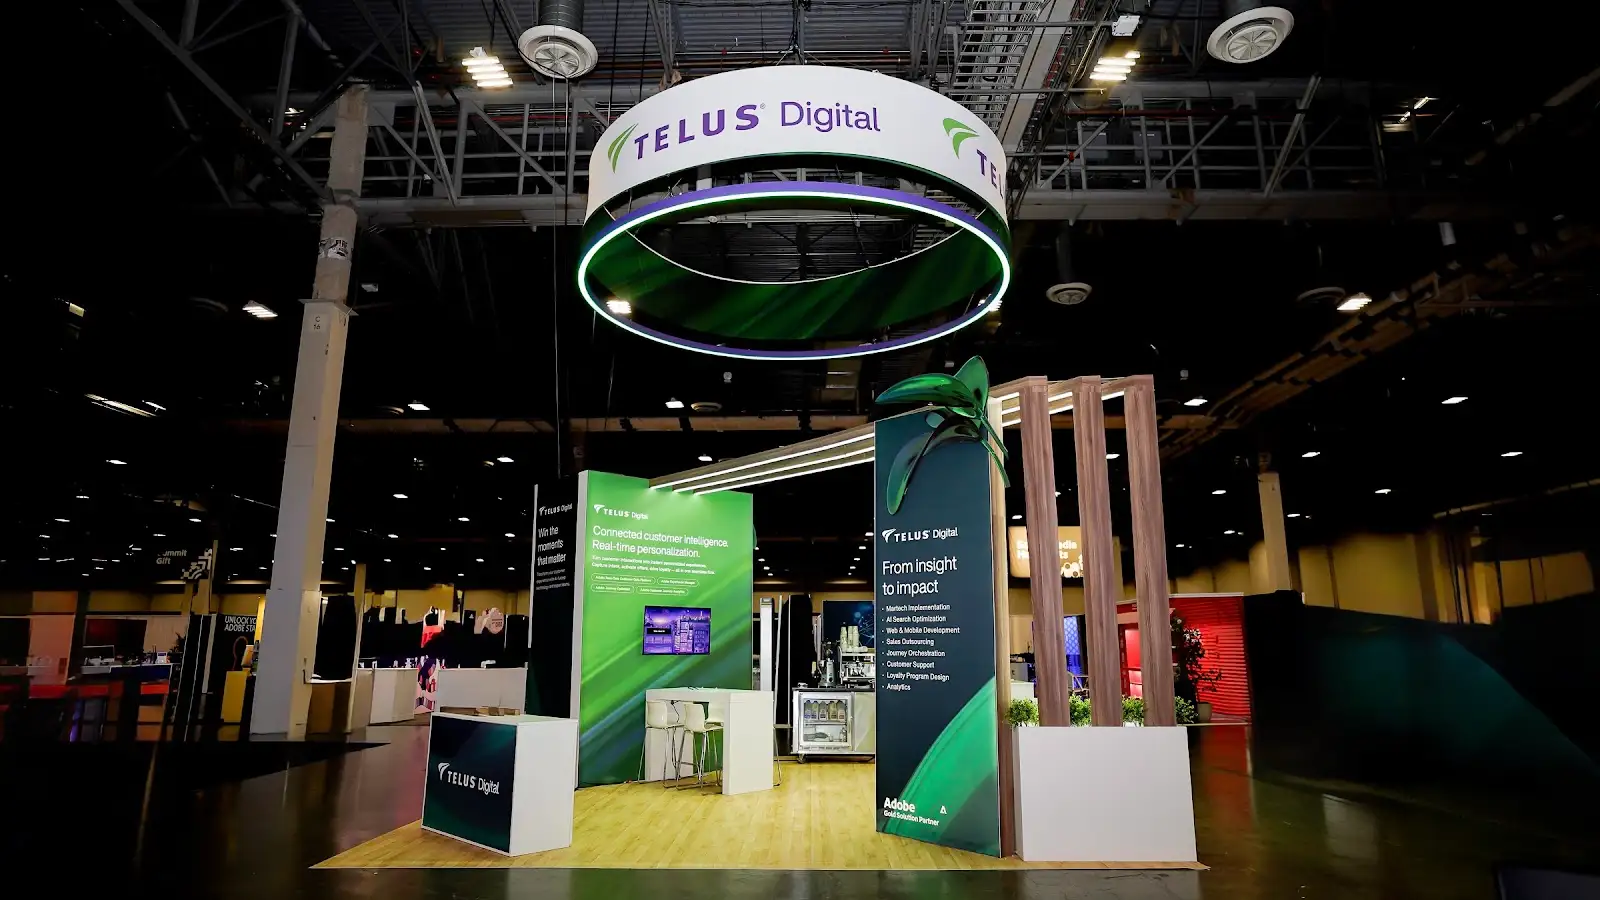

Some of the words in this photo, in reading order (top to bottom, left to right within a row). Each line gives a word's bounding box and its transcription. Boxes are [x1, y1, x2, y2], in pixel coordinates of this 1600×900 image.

[634, 104, 760, 160] TELUS
[781, 101, 881, 133] Digital
[976, 149, 1004, 199] TEL
[544, 505, 560, 515] TELUS
[603, 508, 630, 518] TELUS
[631, 511, 649, 520] Digital
[538, 527, 549, 538] Win
[549, 525, 559, 536] the
[593, 525, 643, 540] Connected
[643, 532, 684, 543] customer
[684, 534, 729, 548] intelligence.
[894, 530, 930, 543] TELUS
[932, 527, 959, 540] Digital
[537, 539, 564, 552] moments
[592, 539, 636, 553] Real-time
[636, 545, 701, 558] personalization.
[537, 555, 548, 566] that
[548, 553, 566, 564] matter
[882, 560, 914, 575] From
[915, 556, 958, 575] insight
[882, 582, 894, 596] to
[896, 580, 939, 597] impact
[908, 603, 951, 612] Implementation
[224, 616, 249, 624] UNLOCK
[912, 615, 947, 623] Optimization
[224, 623, 245, 632] ADOBE
[923, 626, 960, 635] Development
[901, 638, 935, 647] Outsourcing
[886, 650, 907, 658] Journey
[912, 661, 935, 669] Support
[886, 672, 906, 680] Loyalty
[906, 672, 930, 681] Program
[930, 673, 950, 682] Design
[886, 683, 911, 691] Analytics
[447, 770, 476, 789] TELUS
[477, 777, 500, 796] Digital
[883, 796, 916, 813] Adobe
[883, 810, 897, 818] Gold
[896, 812, 919, 823] Solution
[919, 816, 940, 826] Partner
